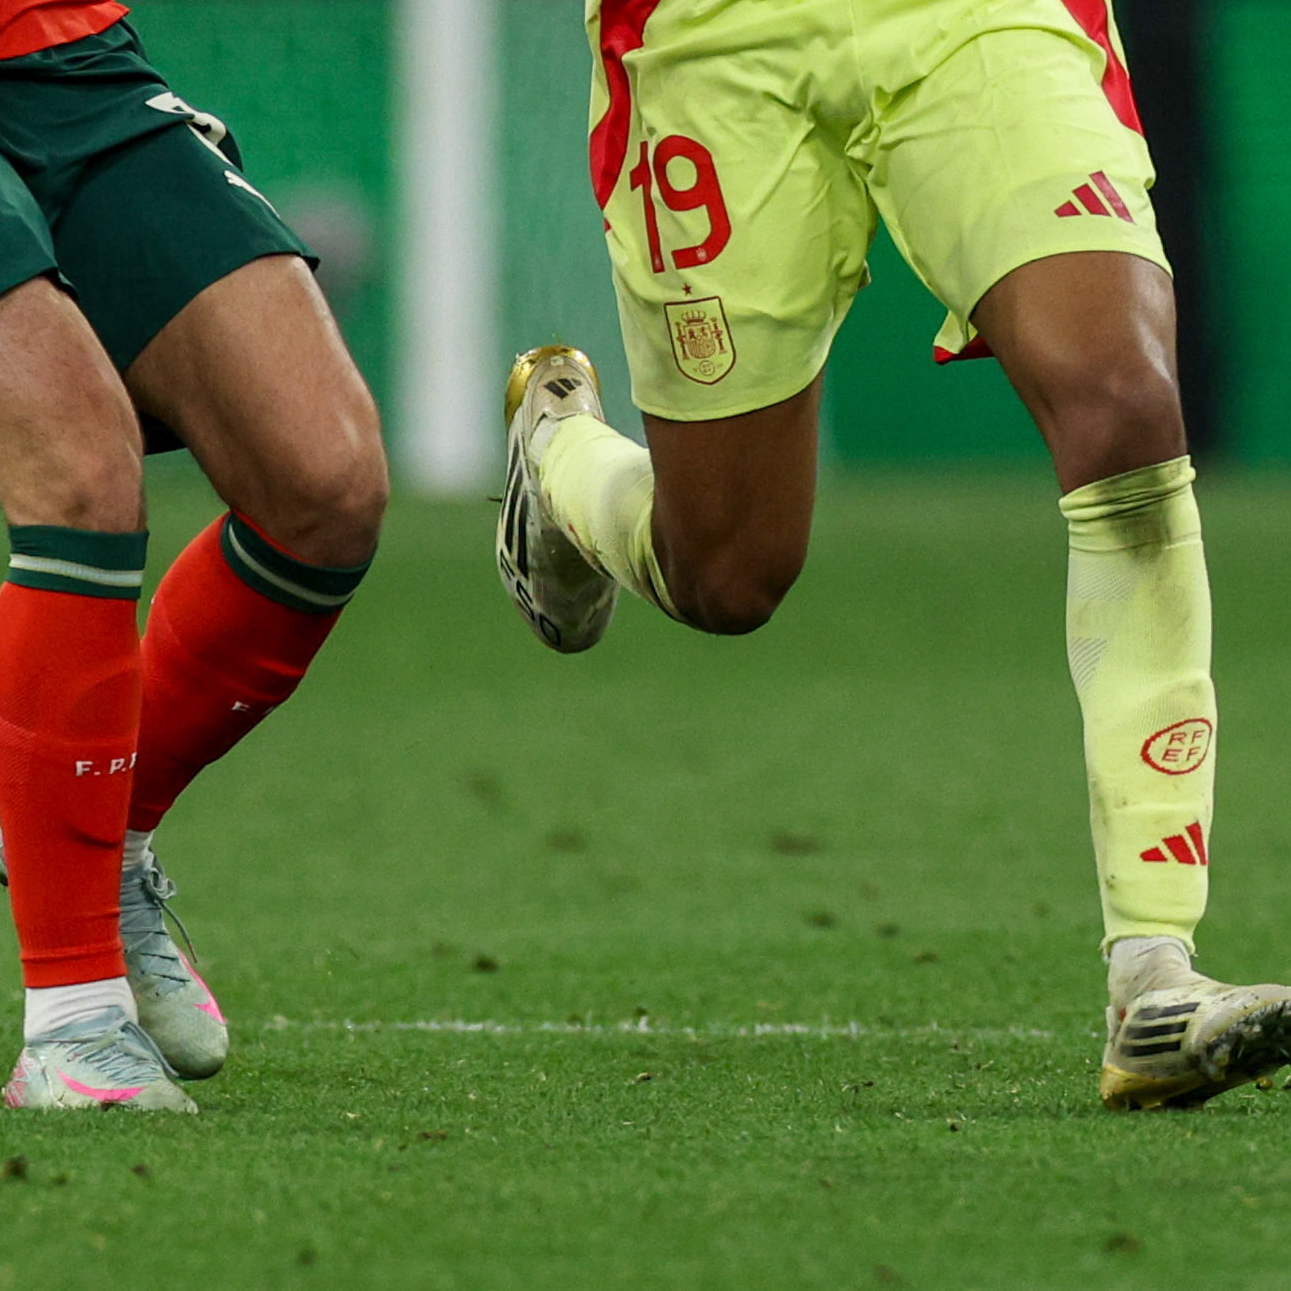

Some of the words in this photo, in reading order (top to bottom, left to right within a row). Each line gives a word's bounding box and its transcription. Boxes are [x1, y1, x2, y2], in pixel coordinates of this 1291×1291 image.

[629, 134, 732, 274] 19
[1169, 729, 1207, 746] RF
[1161, 746, 1201, 763] EF
